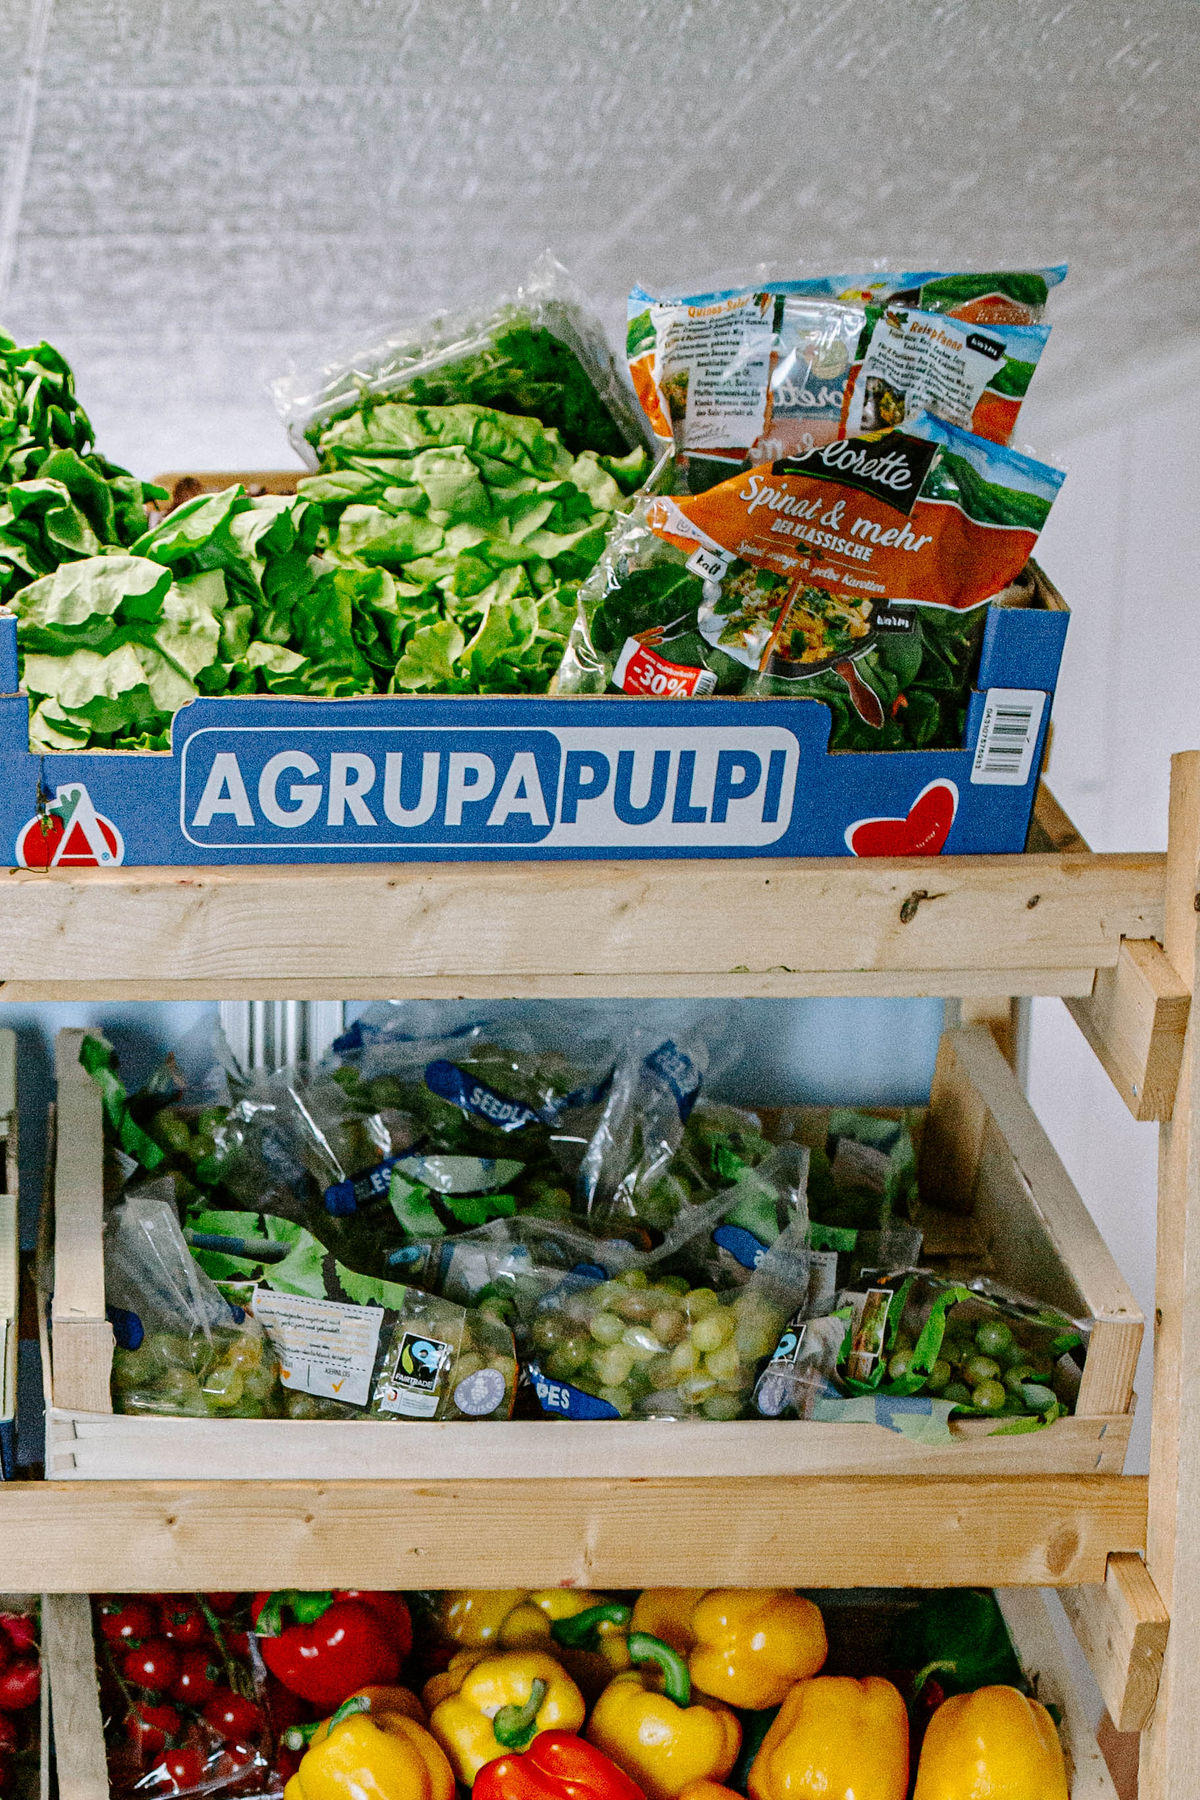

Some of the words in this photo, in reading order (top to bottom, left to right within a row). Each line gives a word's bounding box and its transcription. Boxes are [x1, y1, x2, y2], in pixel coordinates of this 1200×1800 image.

[909, 321, 963, 352] Reispfanne
[739, 474, 824, 521] Spinat
[819, 499, 847, 531] &
[849, 516, 934, 552] mehr
[770, 518, 794, 537] DER
[792, 523, 874, 562] KLASSISCHE
[696, 554, 722, 577] kalt
[840, 571, 886, 593] Karotten
[632, 663, 688, 697] -30%
[395, 1372, 434, 1389] FAIRTRADE
